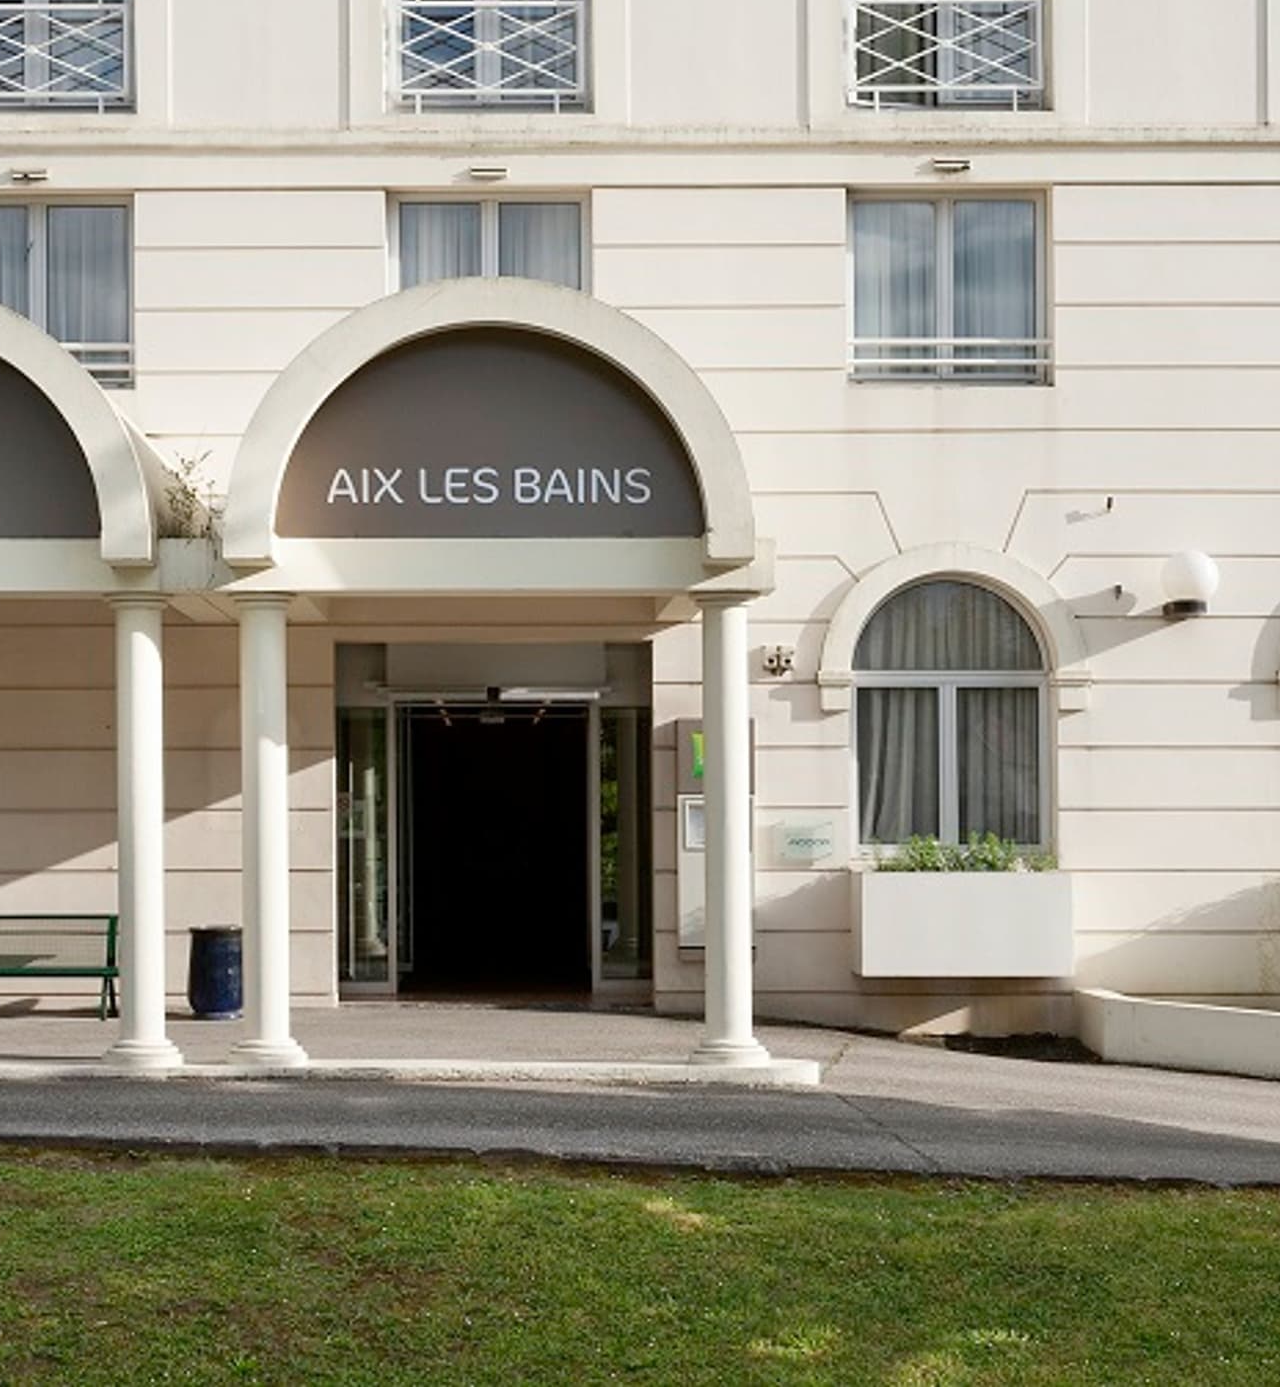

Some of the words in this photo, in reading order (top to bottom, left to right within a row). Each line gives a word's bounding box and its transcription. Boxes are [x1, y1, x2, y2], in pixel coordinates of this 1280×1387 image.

[326, 468, 405, 504] AIX
[419, 468, 500, 504] LES
[513, 468, 652, 504] BAINS
